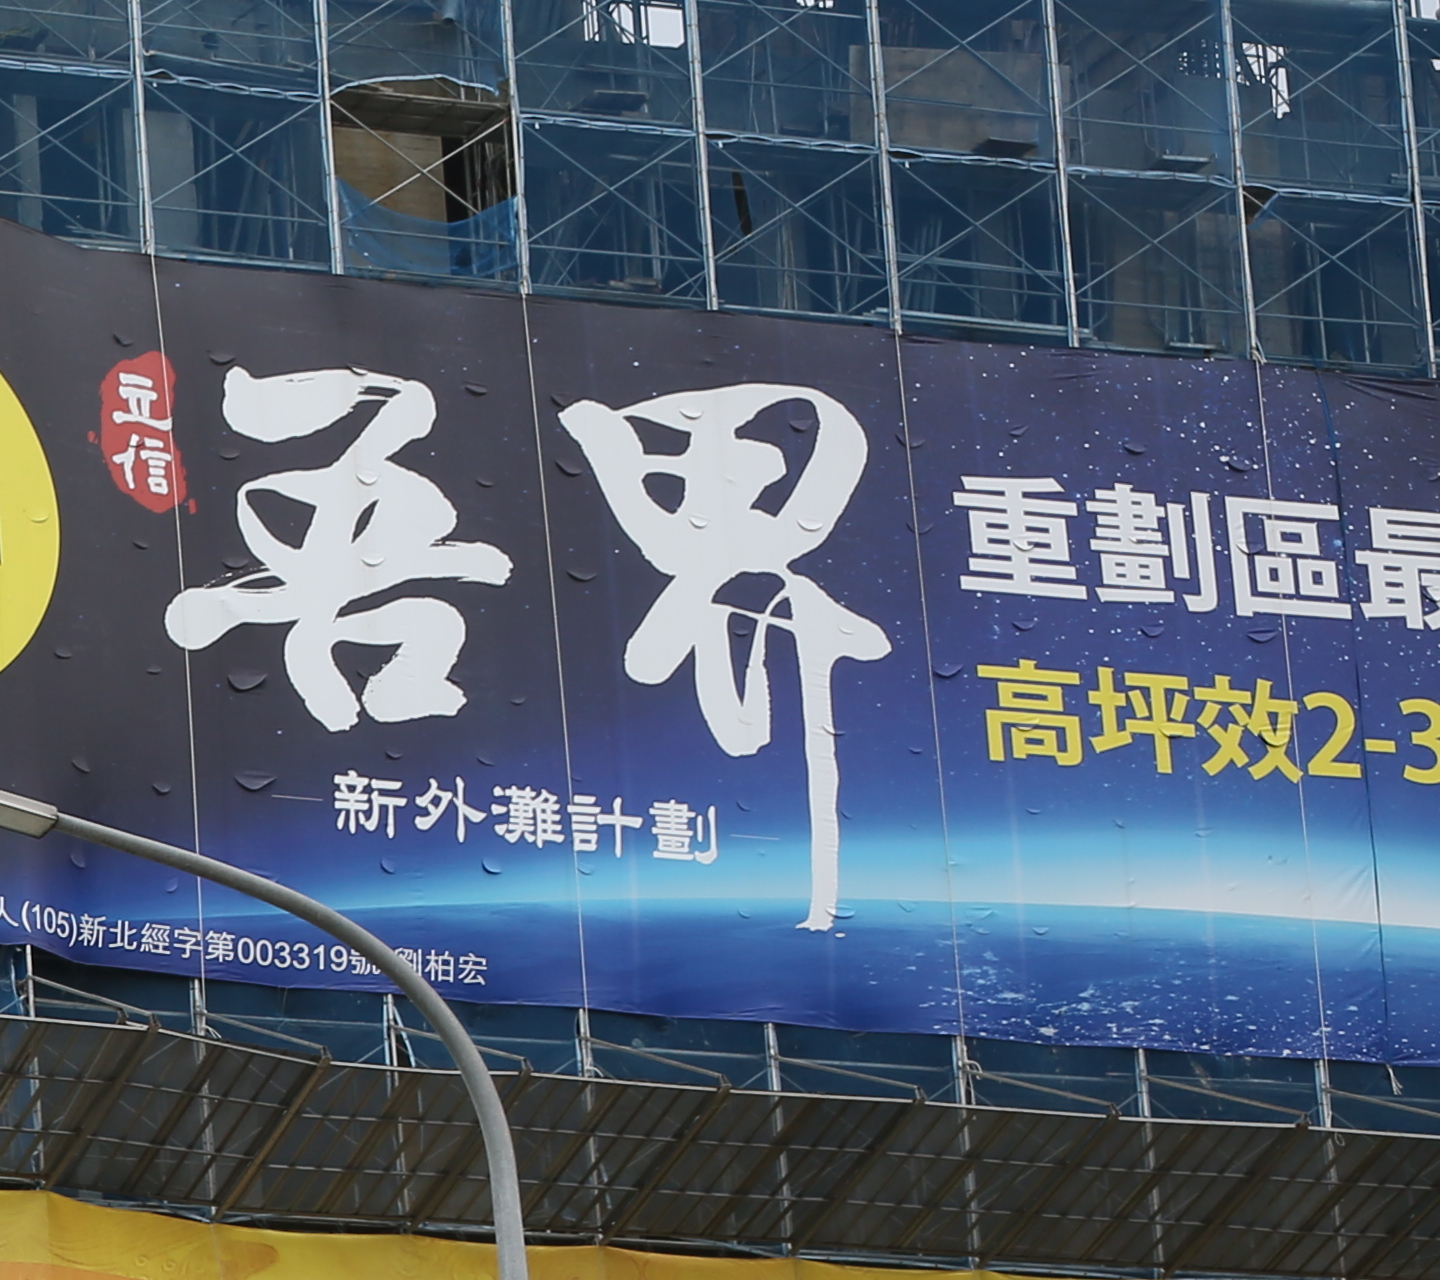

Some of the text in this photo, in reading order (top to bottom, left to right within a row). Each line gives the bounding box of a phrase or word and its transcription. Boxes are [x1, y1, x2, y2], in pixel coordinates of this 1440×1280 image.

[113, 372, 174, 498] 立信
[164, 366, 893, 931] 吾界
[332, 768, 719, 866] 新外灘計劃
